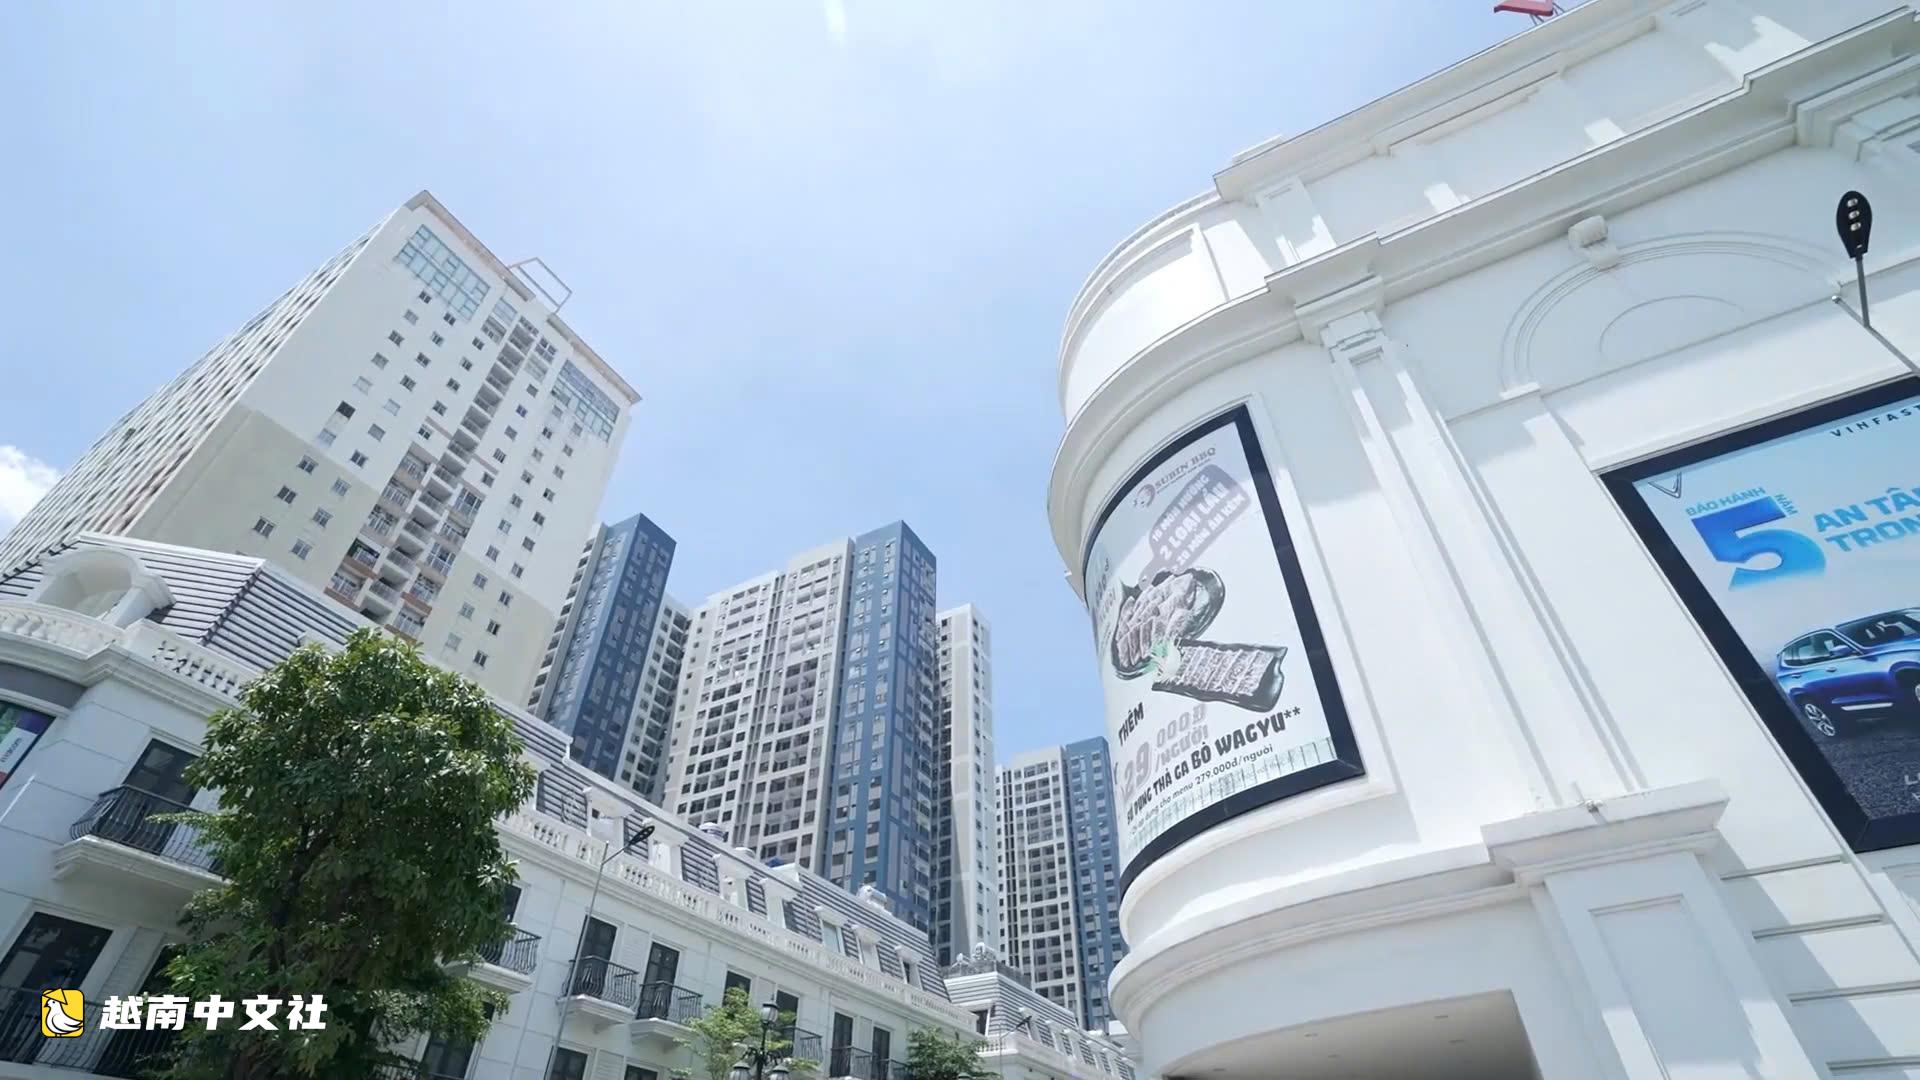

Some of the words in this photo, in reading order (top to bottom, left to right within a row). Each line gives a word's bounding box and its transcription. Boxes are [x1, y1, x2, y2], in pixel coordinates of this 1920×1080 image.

[1191, 447, 1216, 467] BBQ
[1813, 504, 1868, 533] AN
[1864, 486, 1920, 516] TÂ
[1160, 545, 1172, 560] 2
[1168, 510, 1202, 548] LOẠI
[1691, 495, 1826, 592] 5
[1174, 760, 1190, 781] GA
